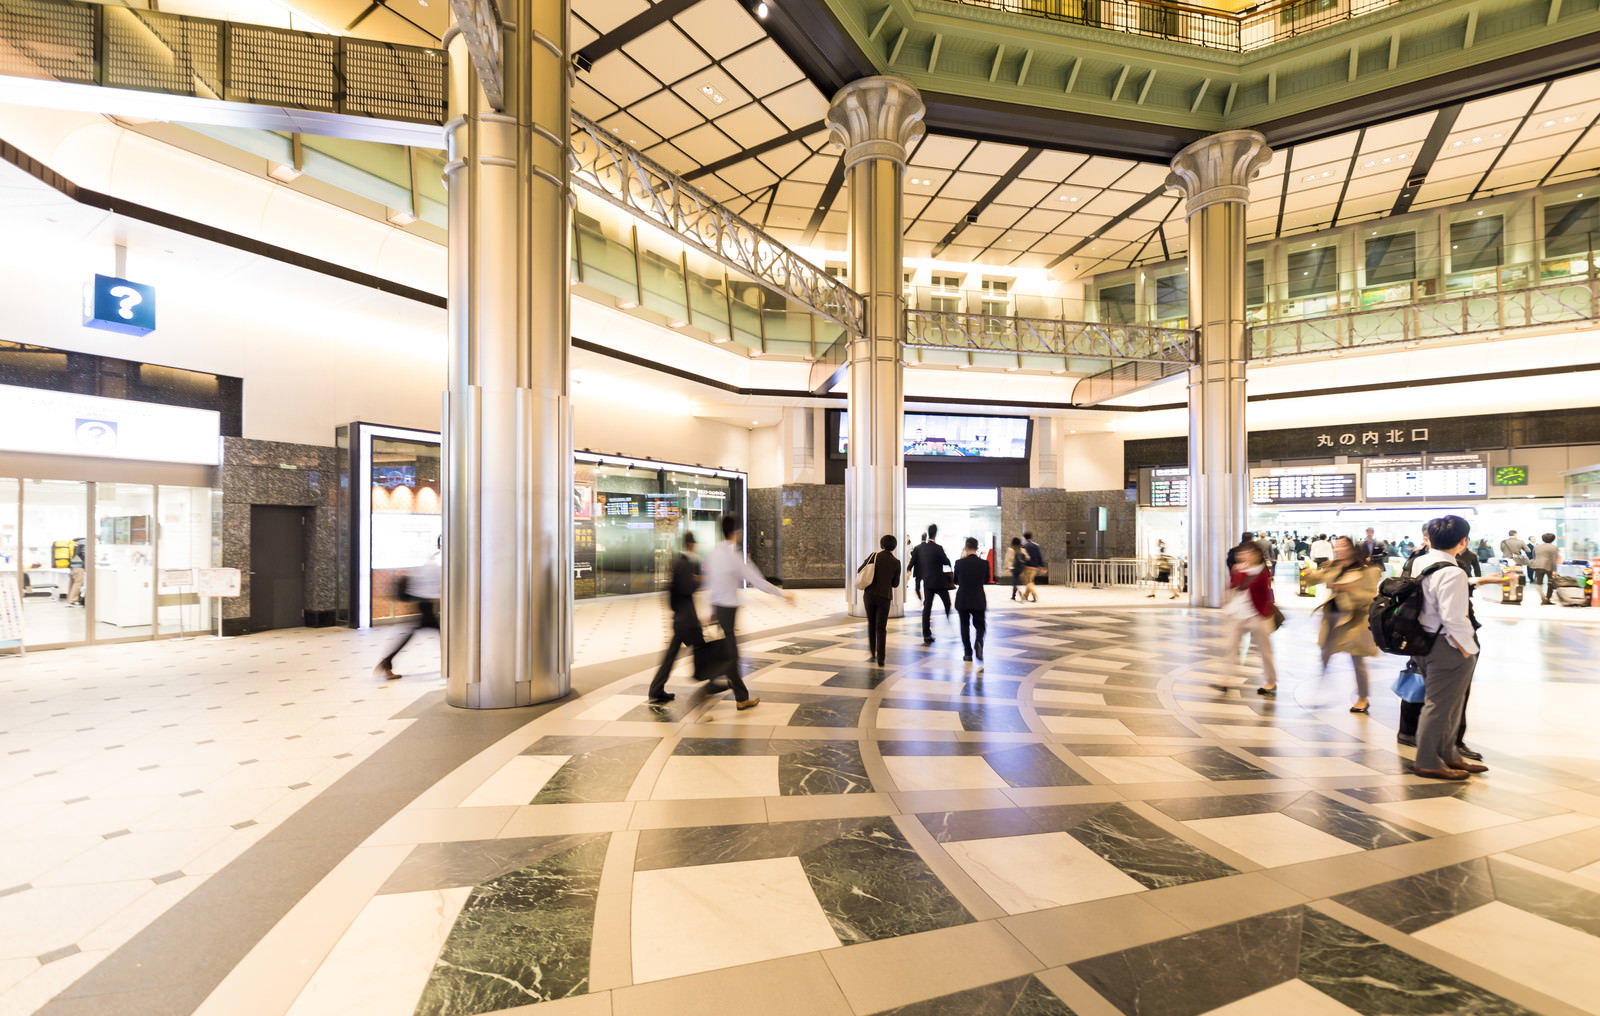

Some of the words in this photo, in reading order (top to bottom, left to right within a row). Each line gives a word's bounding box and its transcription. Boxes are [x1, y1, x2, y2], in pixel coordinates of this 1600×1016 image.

[1316, 428, 1429, 447] 丸の内北口
